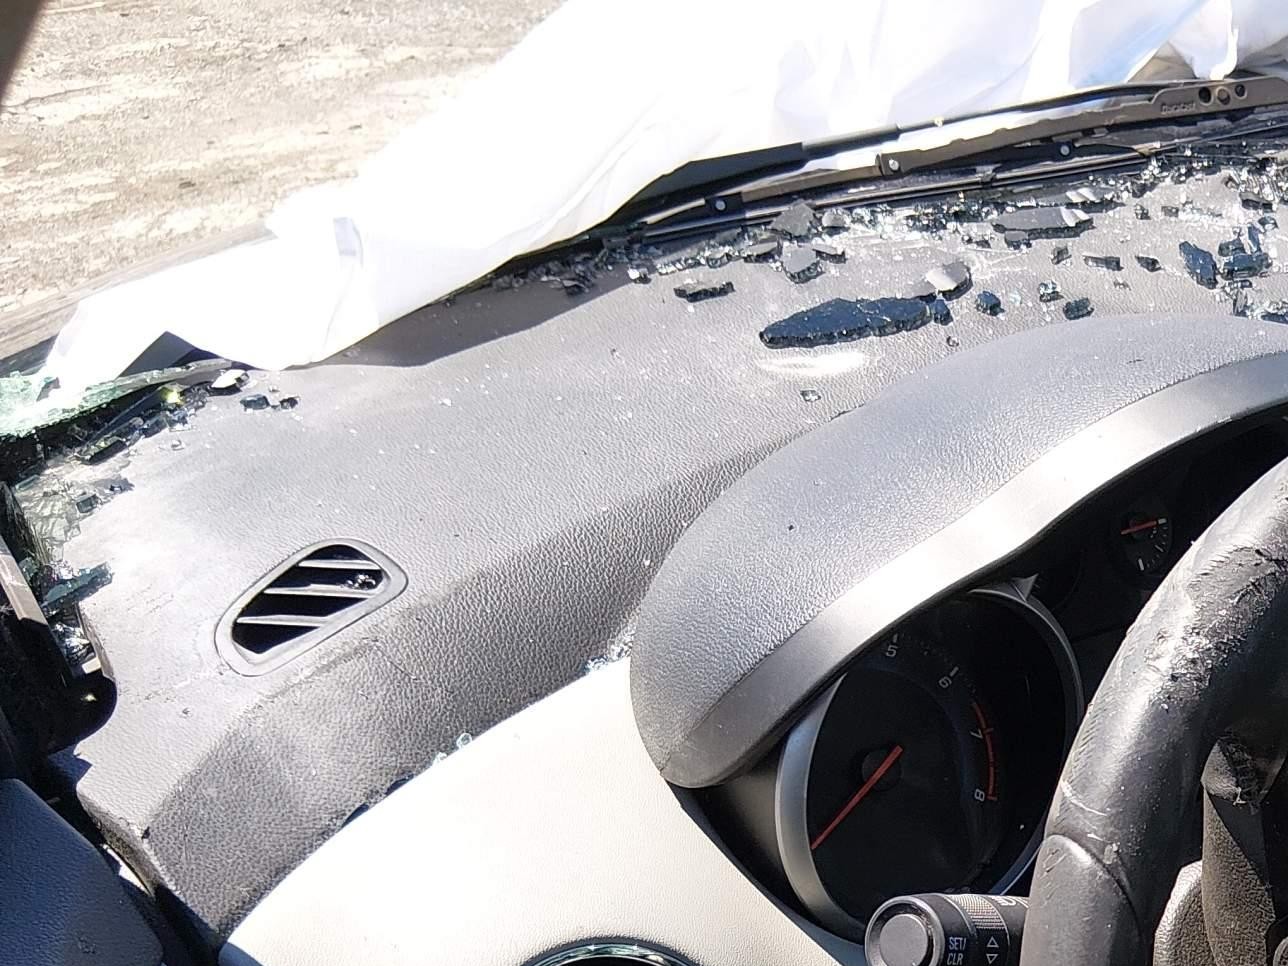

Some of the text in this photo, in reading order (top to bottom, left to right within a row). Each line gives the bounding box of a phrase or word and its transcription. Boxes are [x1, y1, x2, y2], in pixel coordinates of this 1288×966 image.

[886, 645, 897, 658] 5
[938, 675, 952, 689] 6
[974, 788, 985, 802] 8
[948, 936, 967, 951] SET/
[946, 952, 964, 966] CLR
